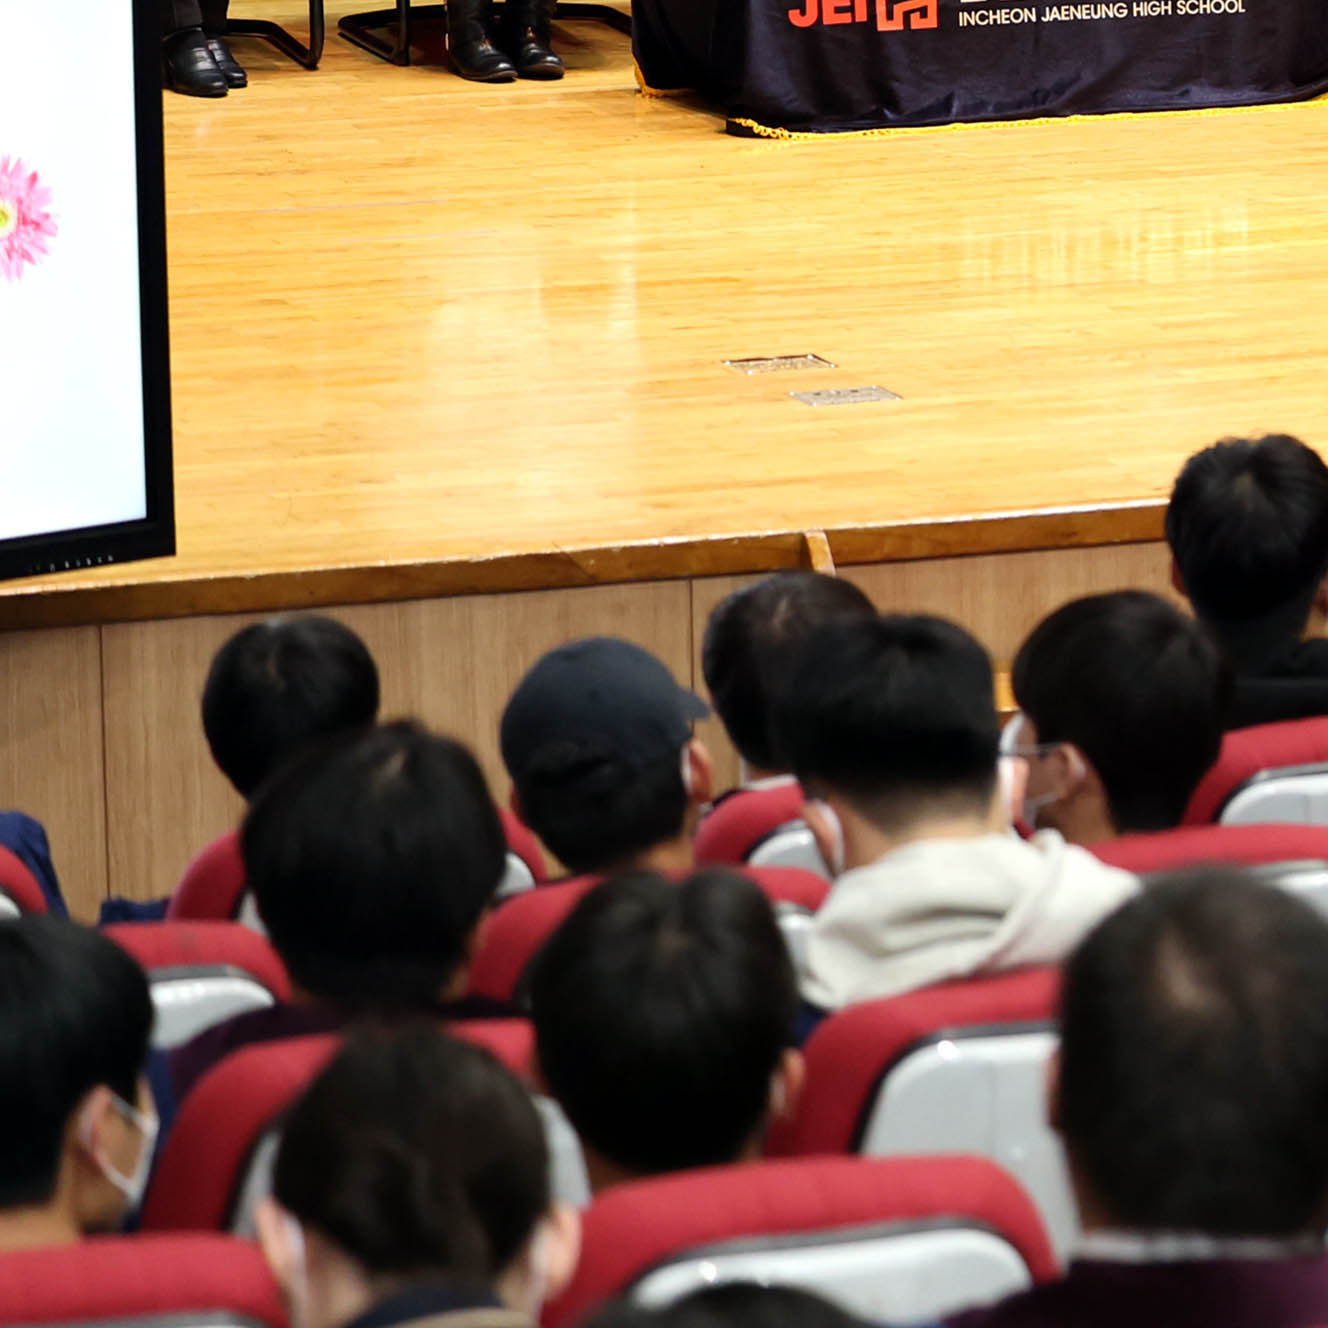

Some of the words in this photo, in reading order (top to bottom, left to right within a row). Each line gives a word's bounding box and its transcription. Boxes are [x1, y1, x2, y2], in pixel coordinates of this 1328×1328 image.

[958, 7, 1037, 27] INCHEON
[1040, 2, 1129, 23] JAENEUNG
[1132, 0, 1172, 17] HIGH
